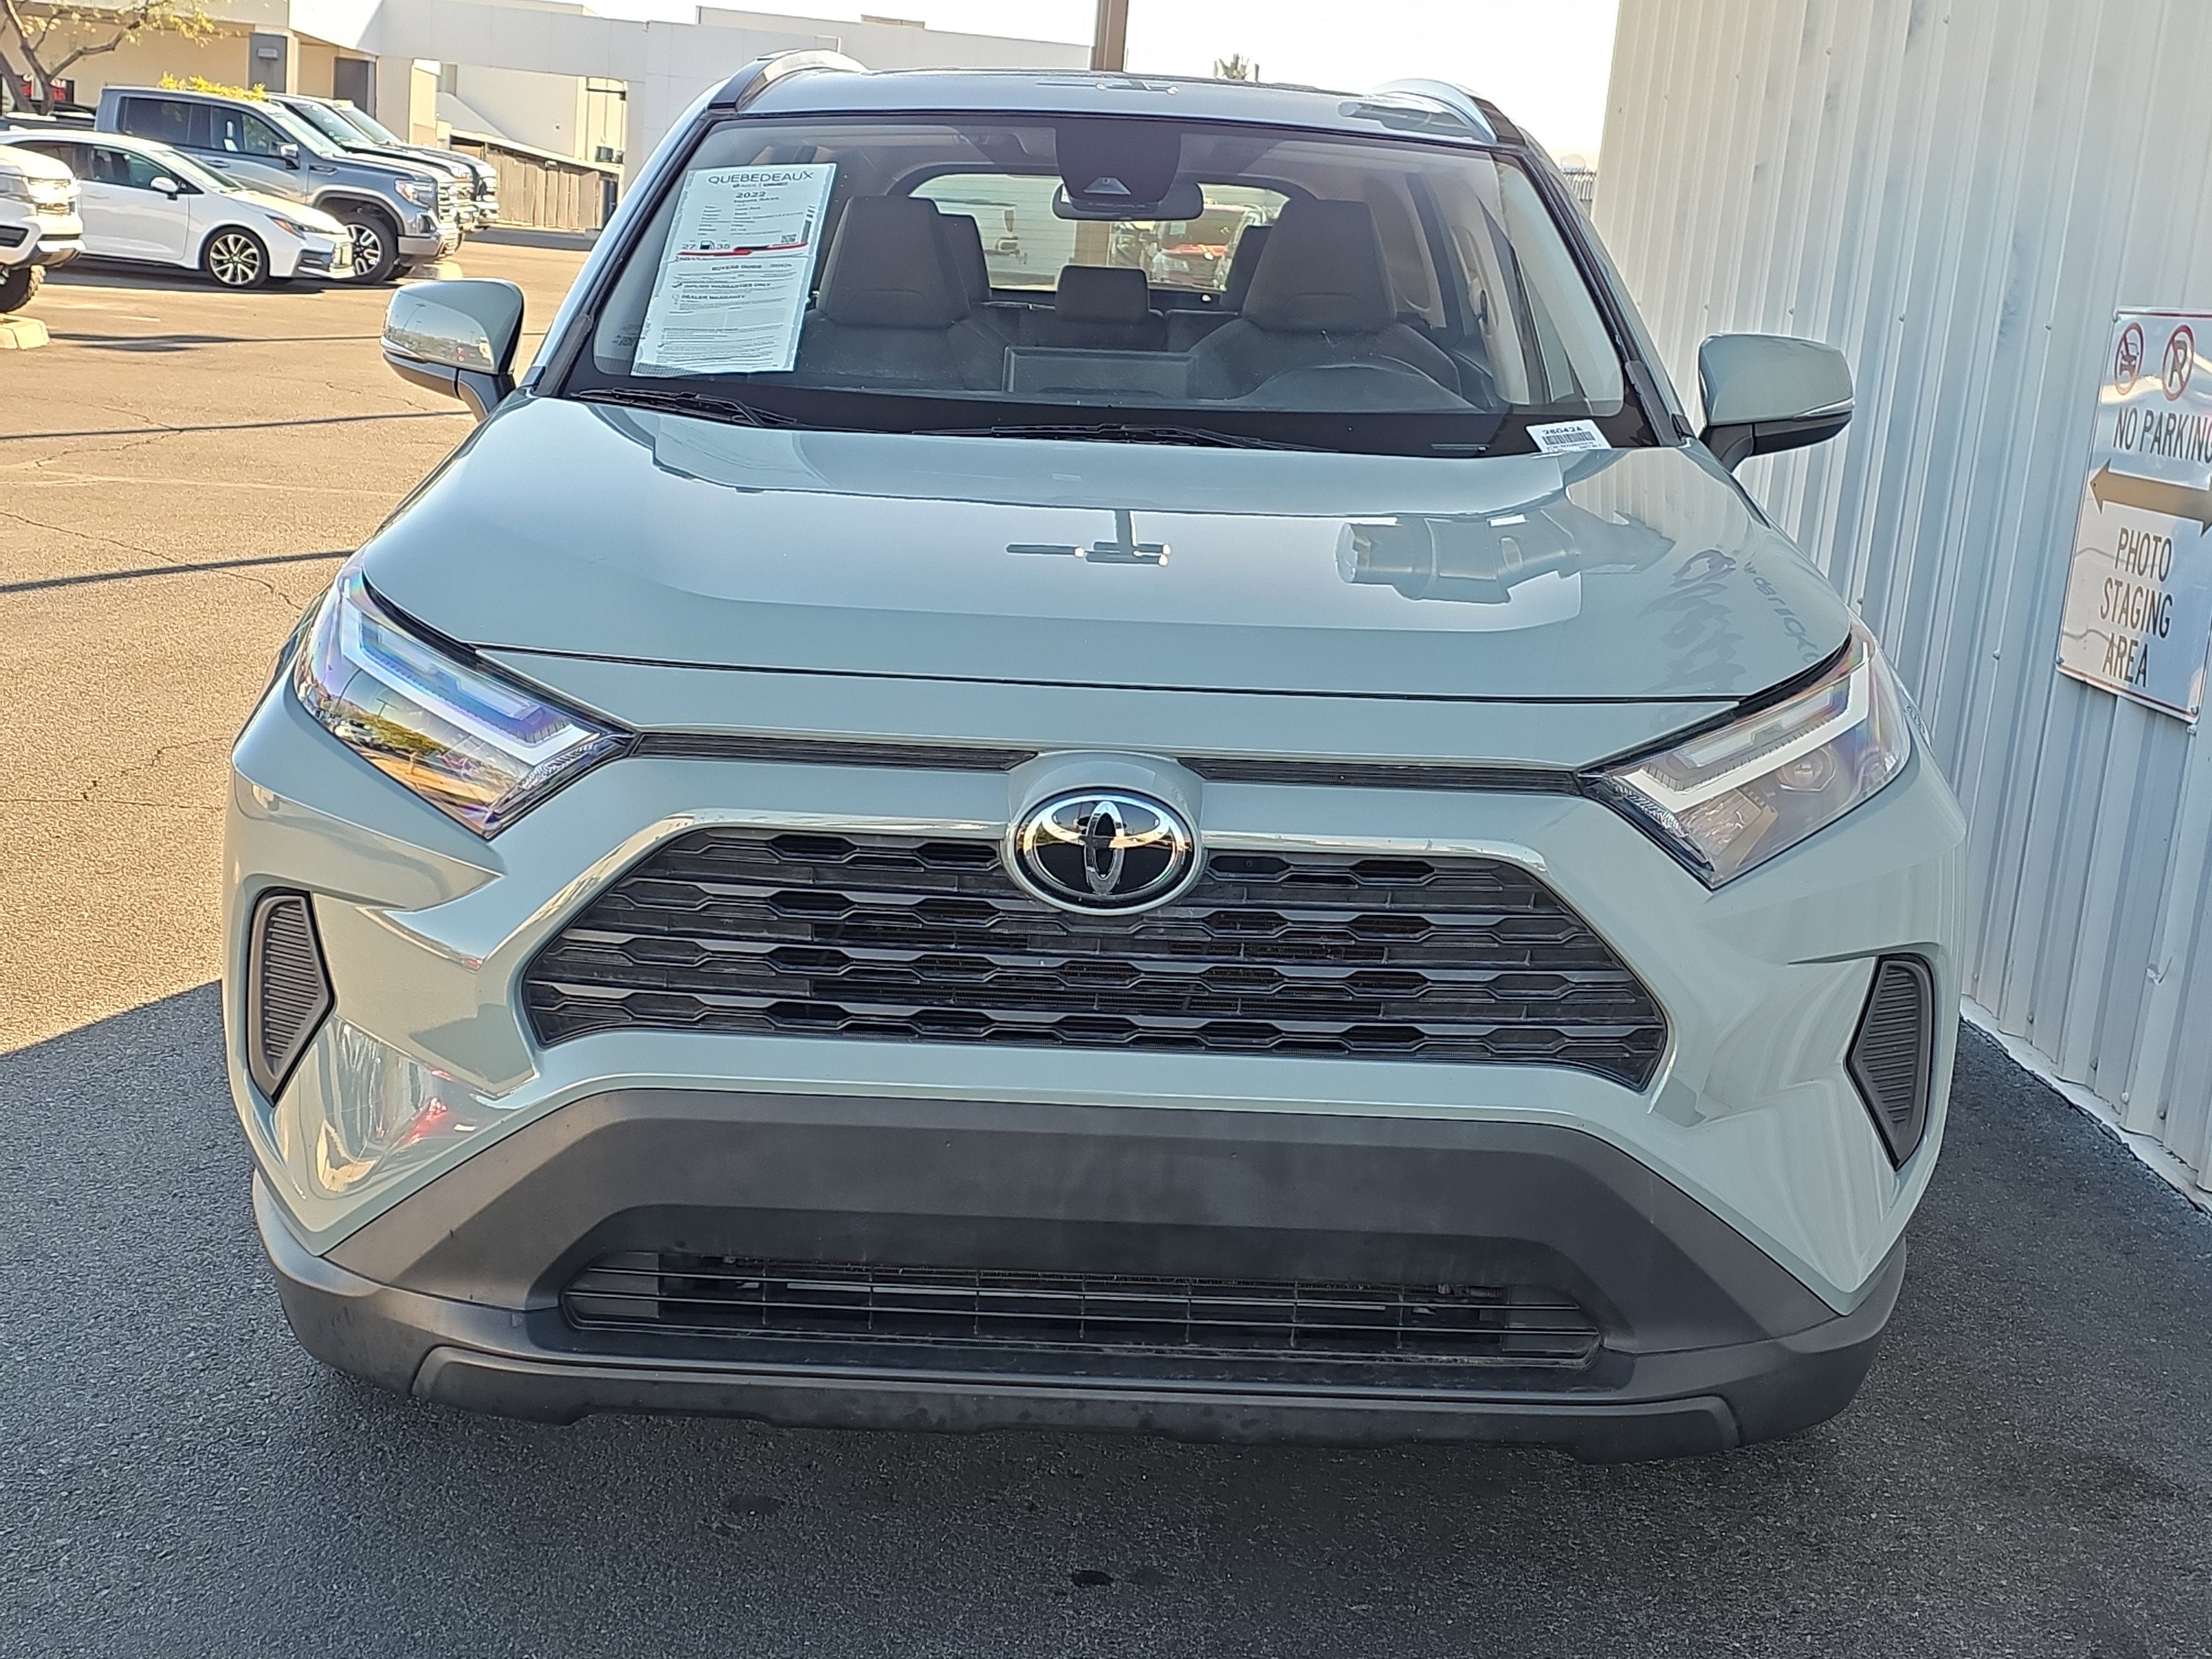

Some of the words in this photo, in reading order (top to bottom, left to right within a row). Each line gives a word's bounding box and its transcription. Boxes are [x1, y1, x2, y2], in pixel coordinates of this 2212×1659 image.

[708, 171, 814, 184] QUEBEDEAUX
[2113, 407, 2138, 450] NO
[2114, 527, 2172, 582] PHOTO
[2100, 577, 2173, 639] STAGING
[2101, 632, 2148, 688] AREA
